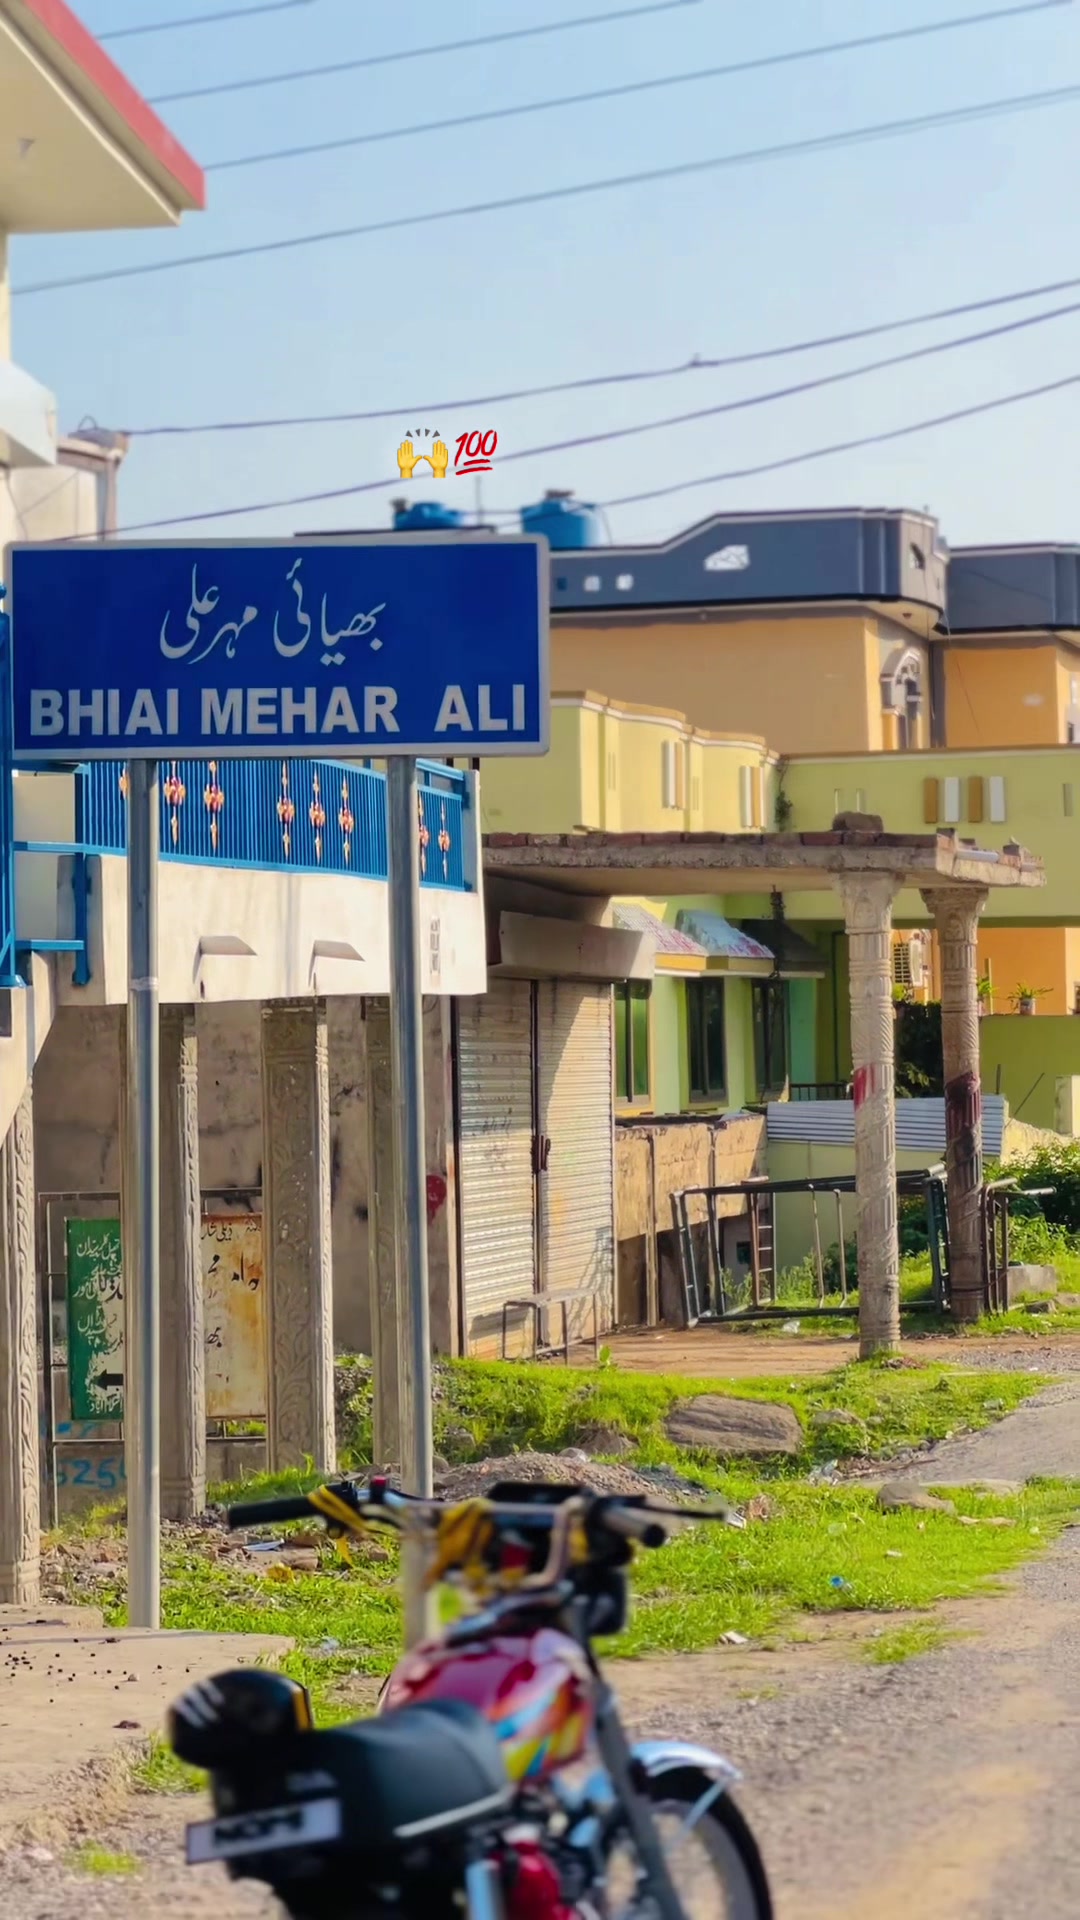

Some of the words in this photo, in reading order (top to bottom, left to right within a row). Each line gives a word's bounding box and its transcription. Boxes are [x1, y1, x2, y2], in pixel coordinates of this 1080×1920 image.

[160, 563, 219, 659] علی
[187, 605, 258, 665] مہر
[30, 689, 179, 735] BHIAI
[201, 686, 400, 735] MEHAR
[434, 684, 525, 732] ALI
